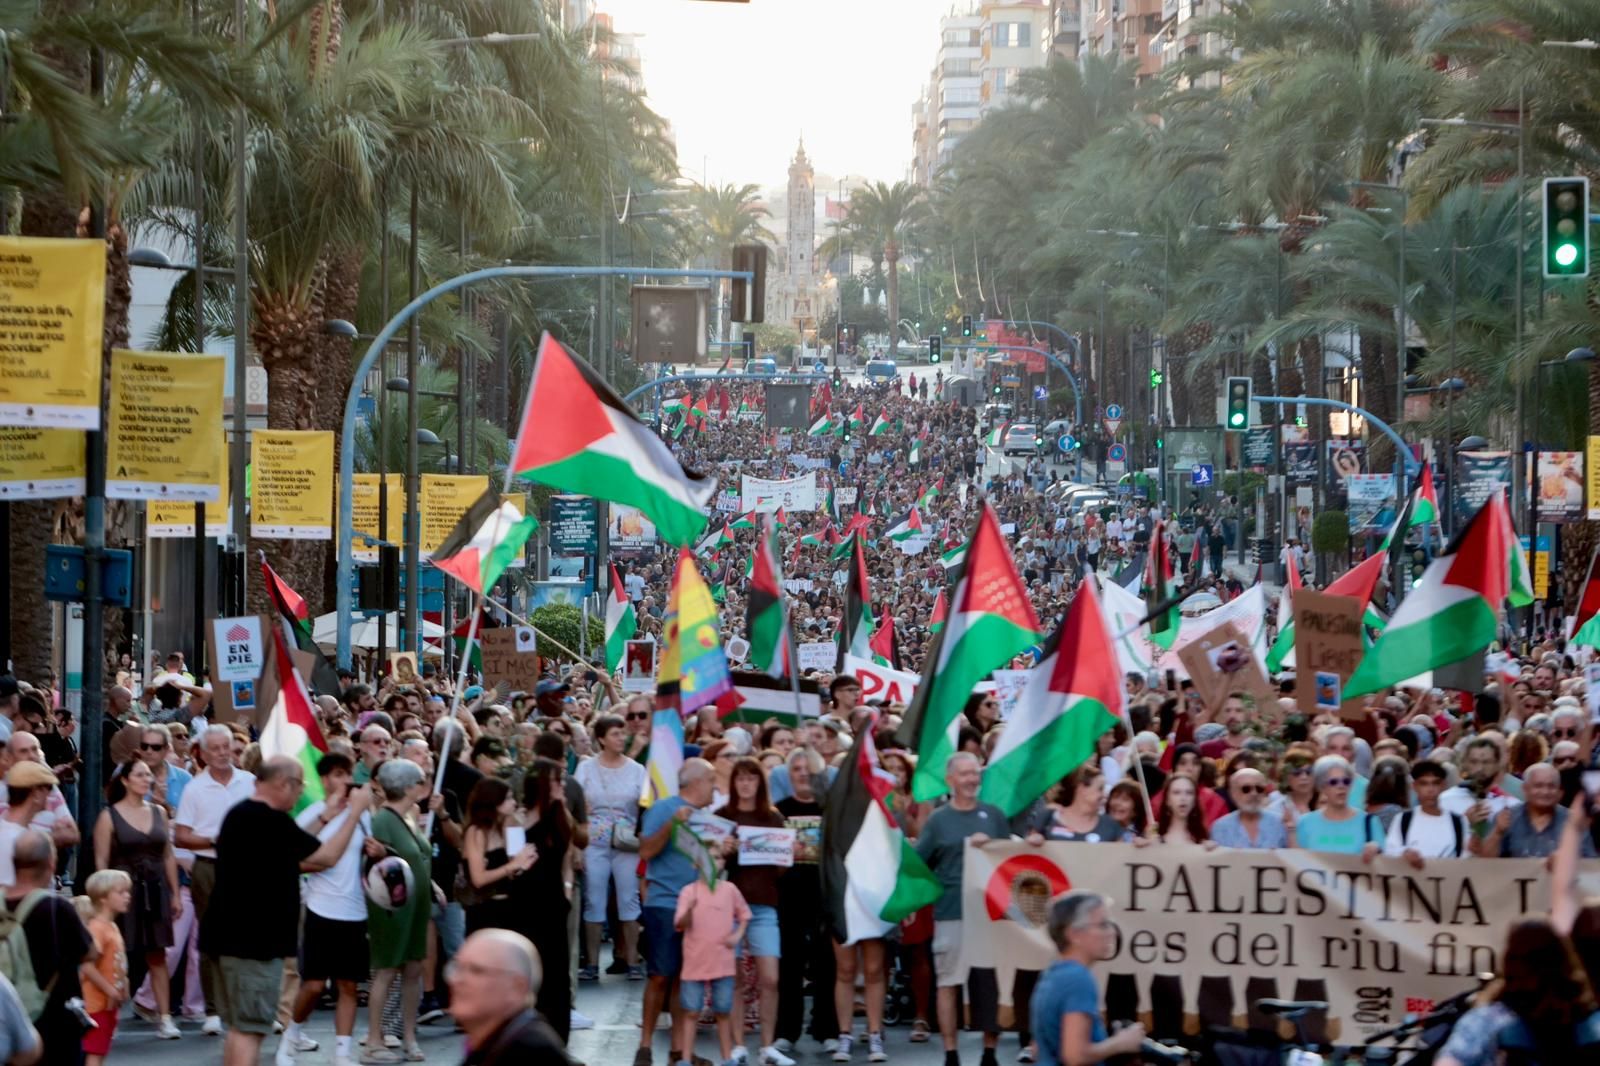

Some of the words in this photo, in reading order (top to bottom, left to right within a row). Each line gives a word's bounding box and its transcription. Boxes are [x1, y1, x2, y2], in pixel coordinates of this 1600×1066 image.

[132, 362, 168, 372] Alicante
[137, 404, 168, 412] verano
[138, 414, 172, 424] historia
[118, 422, 147, 432] contar
[168, 426, 192, 434] arroz
[228, 643, 250, 654] EN
[228, 654, 252, 664] PIE
[1125, 863, 1490, 926] PALESTINA
[1211, 922, 1299, 967] del
[1320, 928, 1406, 974] riu
